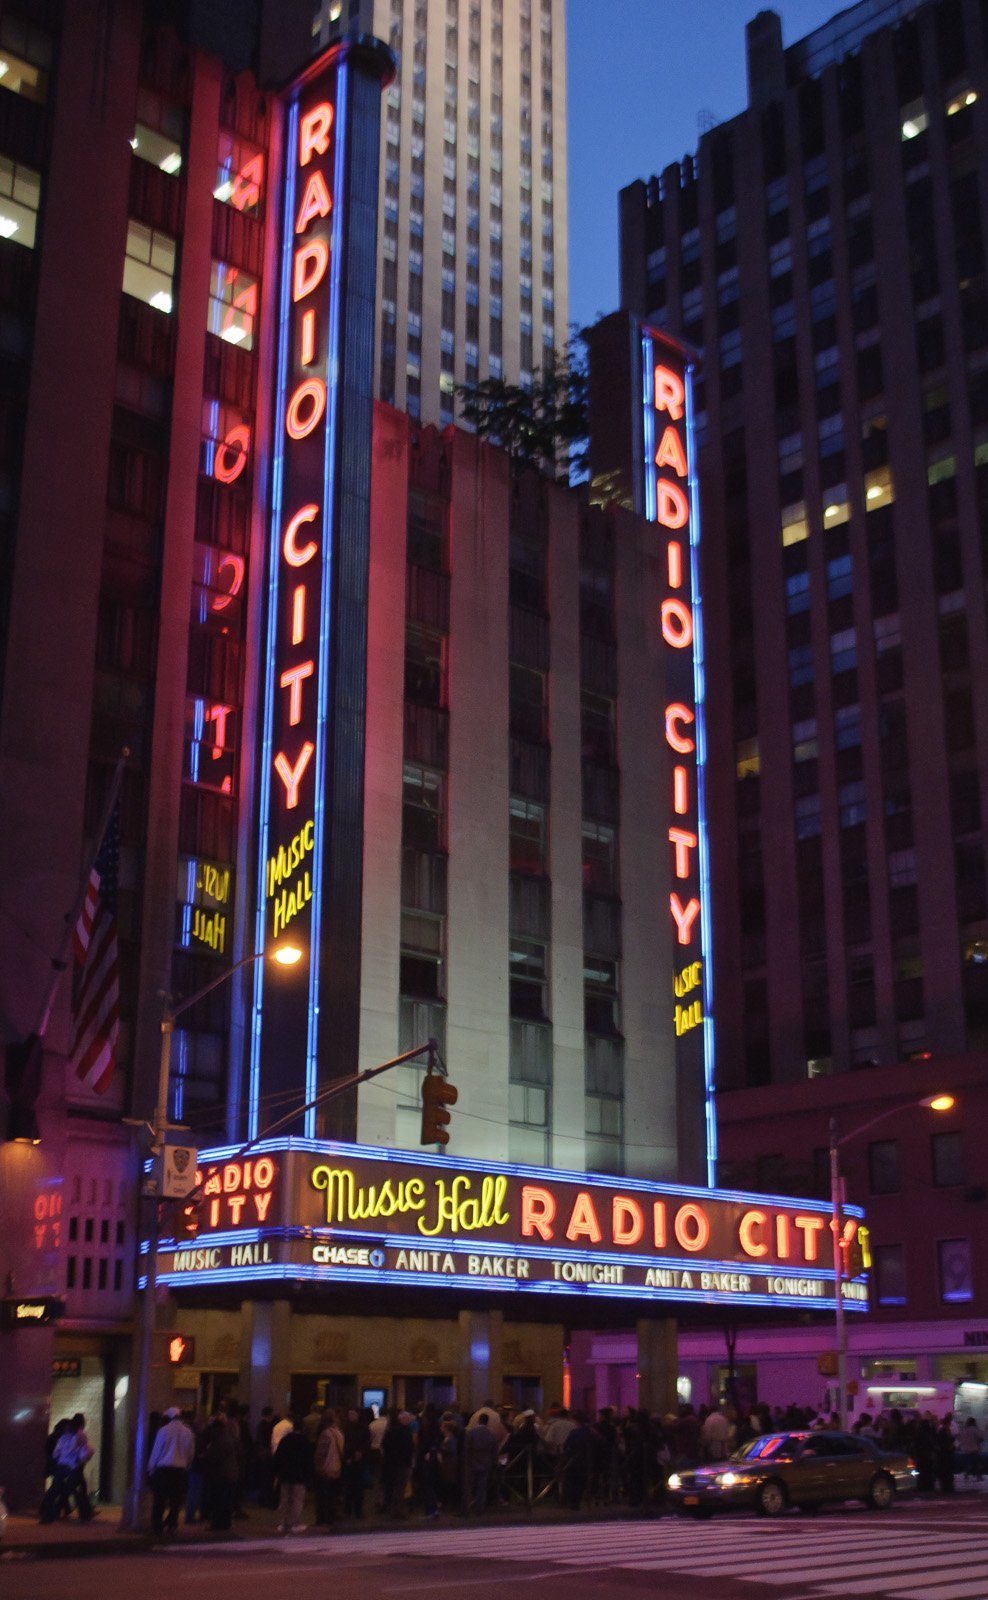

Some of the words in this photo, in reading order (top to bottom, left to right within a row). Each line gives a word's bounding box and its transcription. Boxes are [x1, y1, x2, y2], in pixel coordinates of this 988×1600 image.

[287, 102, 334, 440] RADIO
[655, 365, 693, 648] RADIO
[275, 504, 319, 809] CITY
[665, 702, 700, 945] CITY
[266, 819, 315, 898] MUSIC
[274, 871, 312, 938] HALL
[673, 961, 703, 998] USIC
[311, 1165, 426, 1223] Music
[417, 1175, 510, 1236] Hall
[521, 1184, 709, 1252] RADIO
[173, 1247, 221, 1272] MUSIC
[230, 1242, 273, 1267] HALL
[312, 1245, 370, 1266] CHASE
[395, 1249, 456, 1273] ANITA
[468, 1255, 530, 1278] BAKER
[551, 1260, 625, 1285] TONIGHT
[644, 1268, 693, 1290] ANITA
[700, 1271, 751, 1293] BAKER
[766, 1276, 825, 1297] TONIGHT
